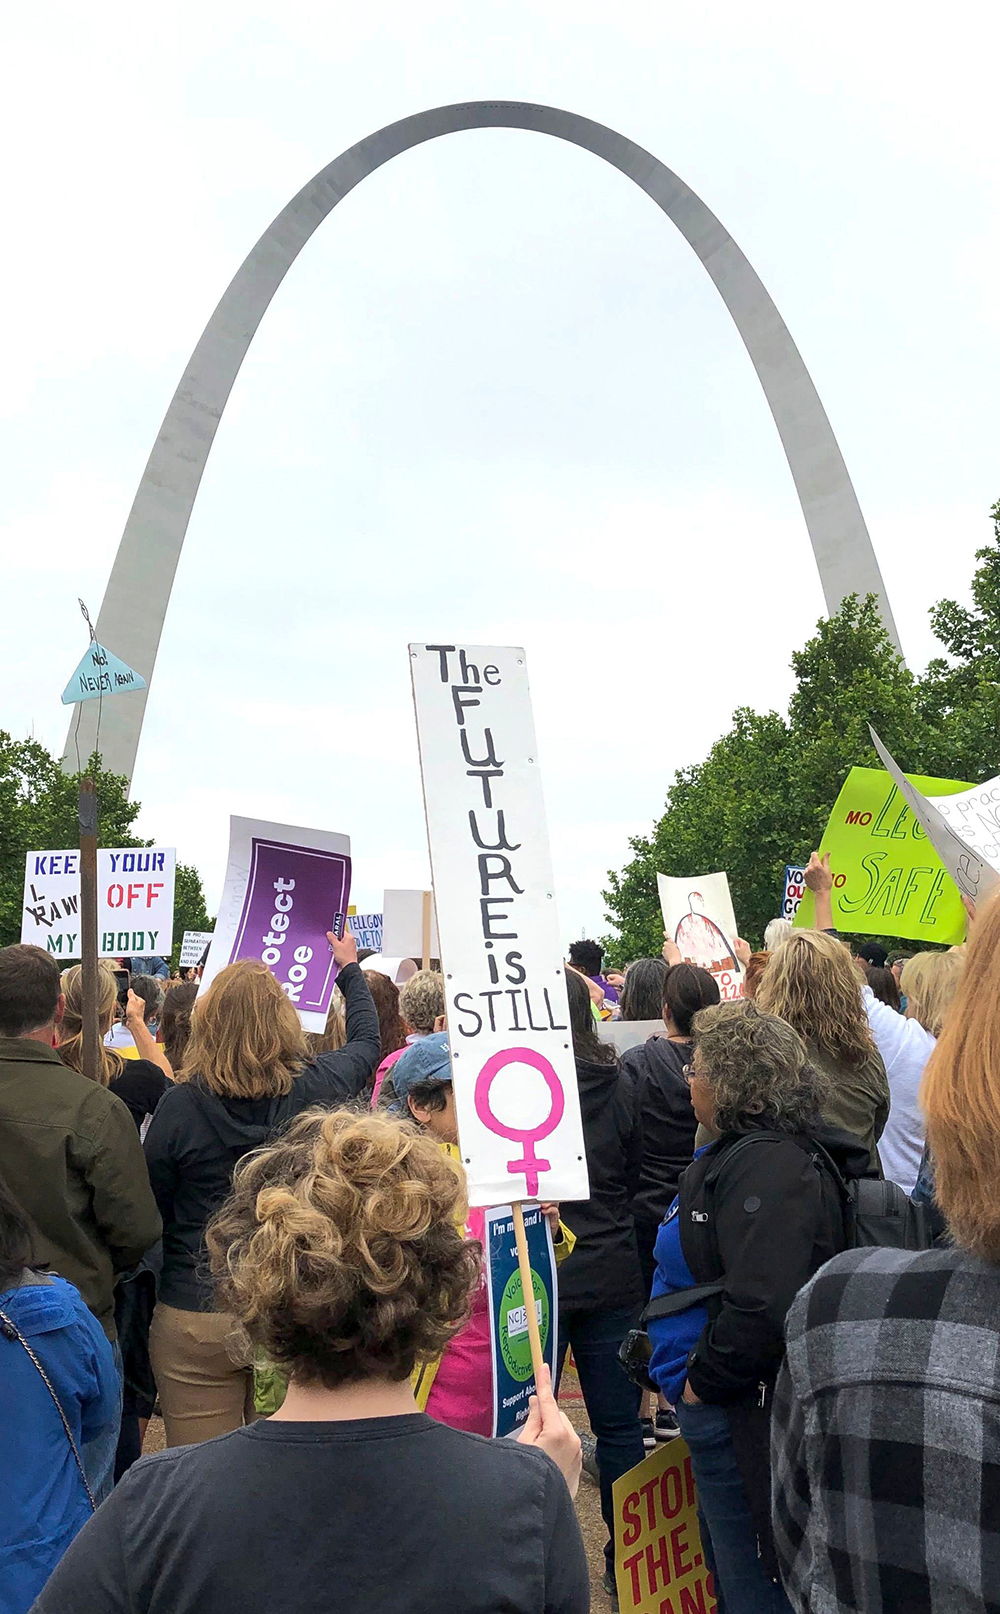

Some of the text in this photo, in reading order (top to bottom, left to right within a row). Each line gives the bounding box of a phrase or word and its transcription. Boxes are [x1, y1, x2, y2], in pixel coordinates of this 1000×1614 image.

[425, 645, 501, 685] The
[79, 672, 112, 693] NEVER
[845, 811, 872, 826] MO
[35, 853, 165, 875] KEE YOUR
[787, 870, 804, 884] VO
[107, 883, 164, 909] OFF
[787, 885, 806, 898] OU
[831, 852, 949, 924] O SAFE
[261, 877, 296, 966] otect
[347, 915, 367, 930] TELL
[47, 931, 159, 953] MY BODY
[280, 945, 313, 1002] Roe
[453, 988, 568, 1037] STILL
[525, 1212, 537, 1227] and
[506, 1278, 522, 1299] Voic
[503, 1389, 524, 1408] Support
